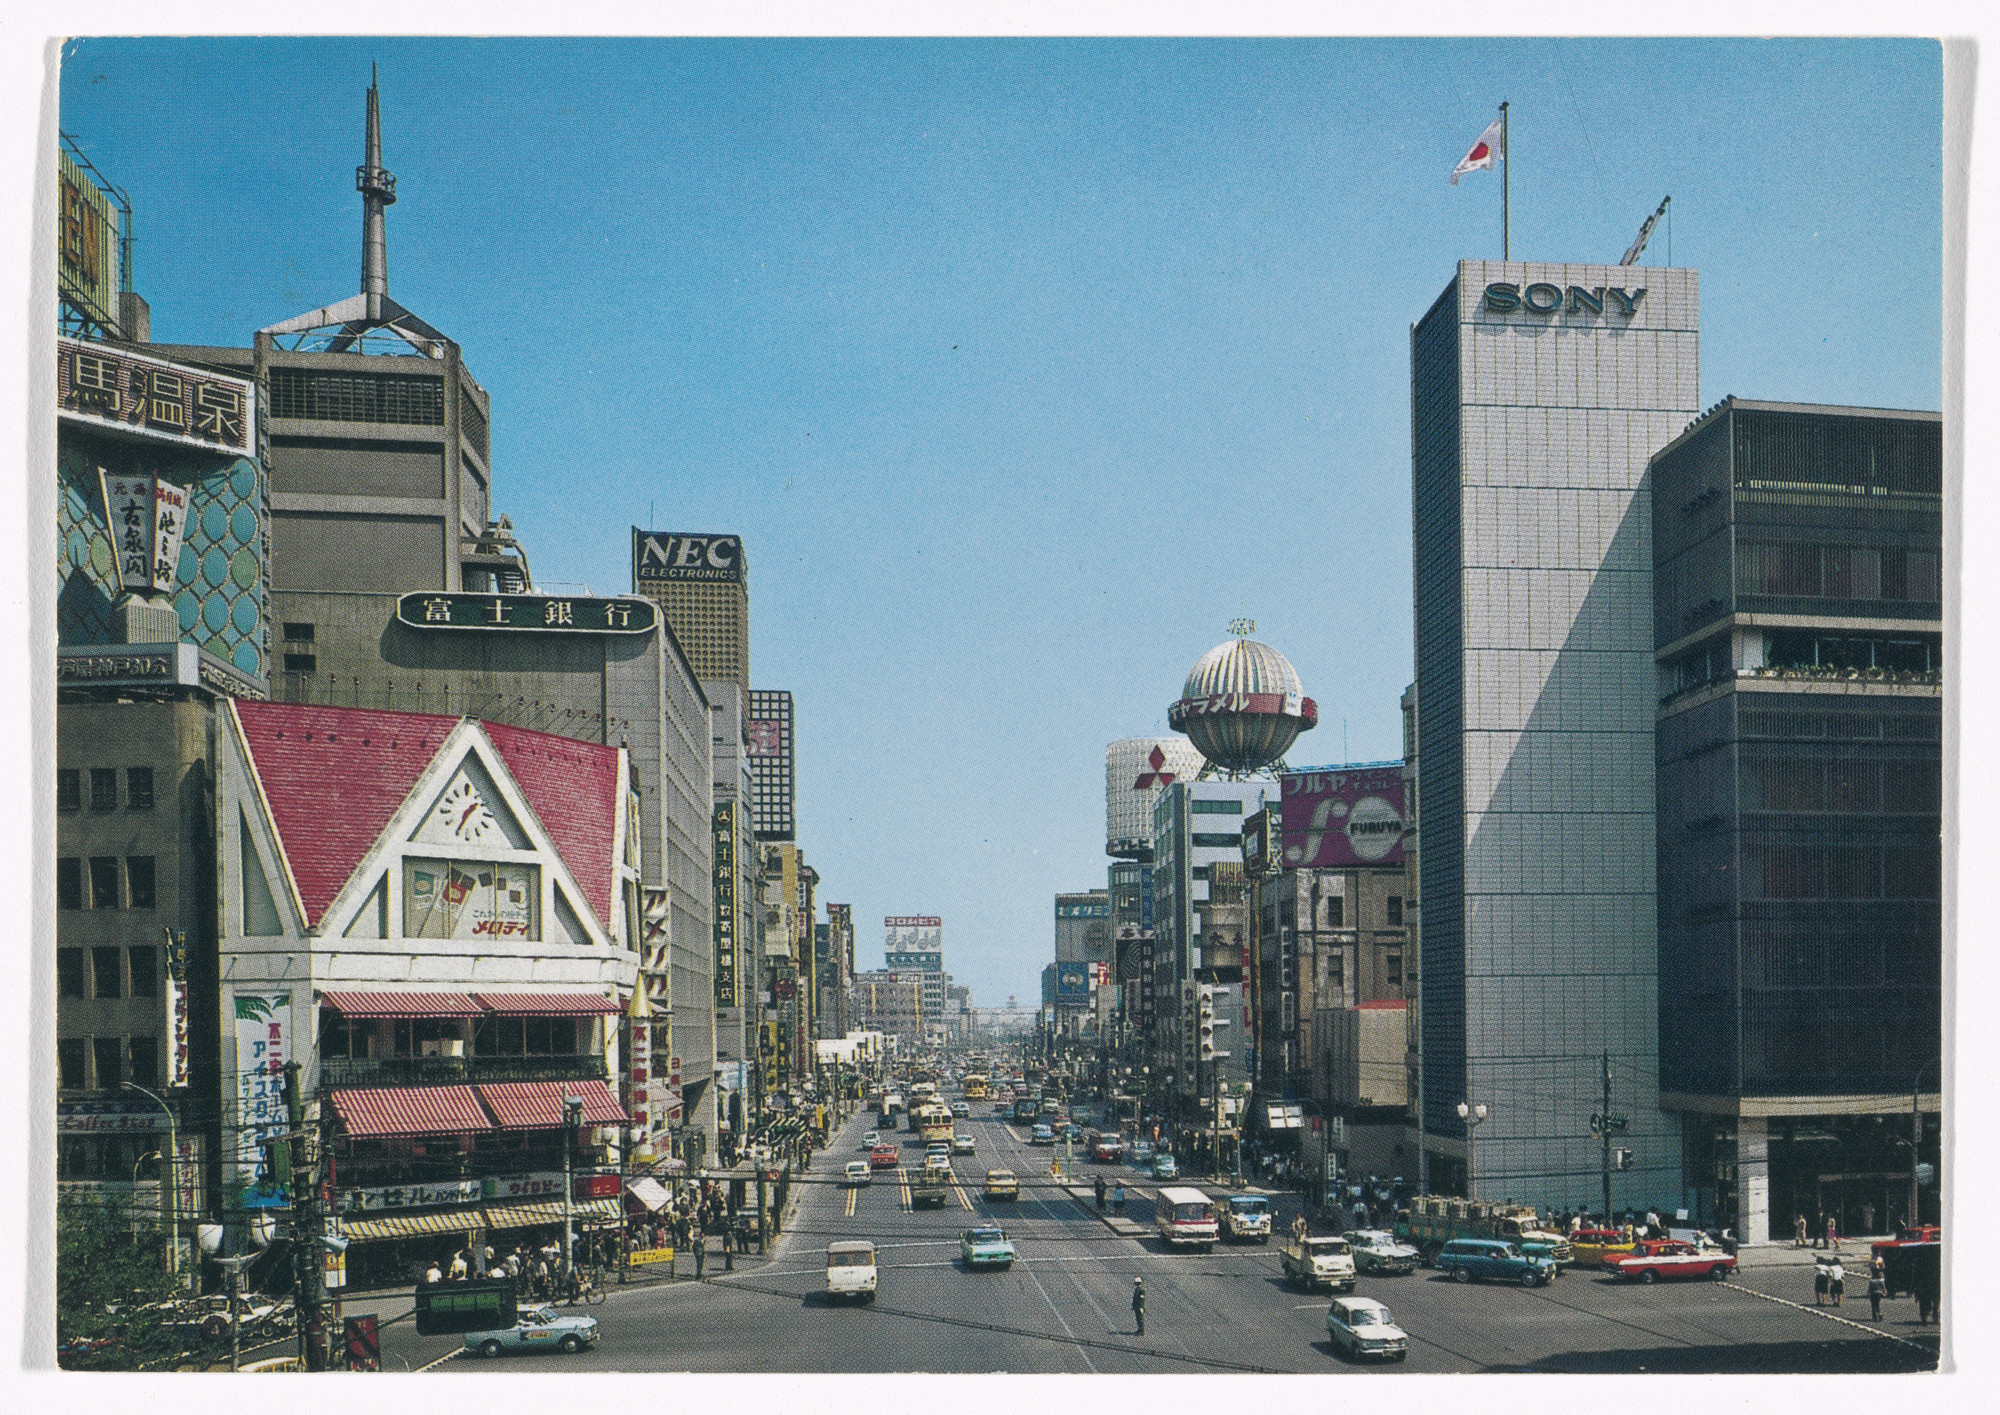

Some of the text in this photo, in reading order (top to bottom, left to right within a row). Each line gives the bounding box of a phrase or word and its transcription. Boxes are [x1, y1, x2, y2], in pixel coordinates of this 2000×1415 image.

[1484, 282, 1648, 315] SONY
[640, 535, 737, 568] NEC
[640, 567, 737, 580] ELECTRONICS
[423, 597, 632, 628] 富士銀行
[1284, 773, 1348, 796] フルヤ
[1350, 821, 1402, 835] FURUYA
[472, 920, 530, 936] メロディ
